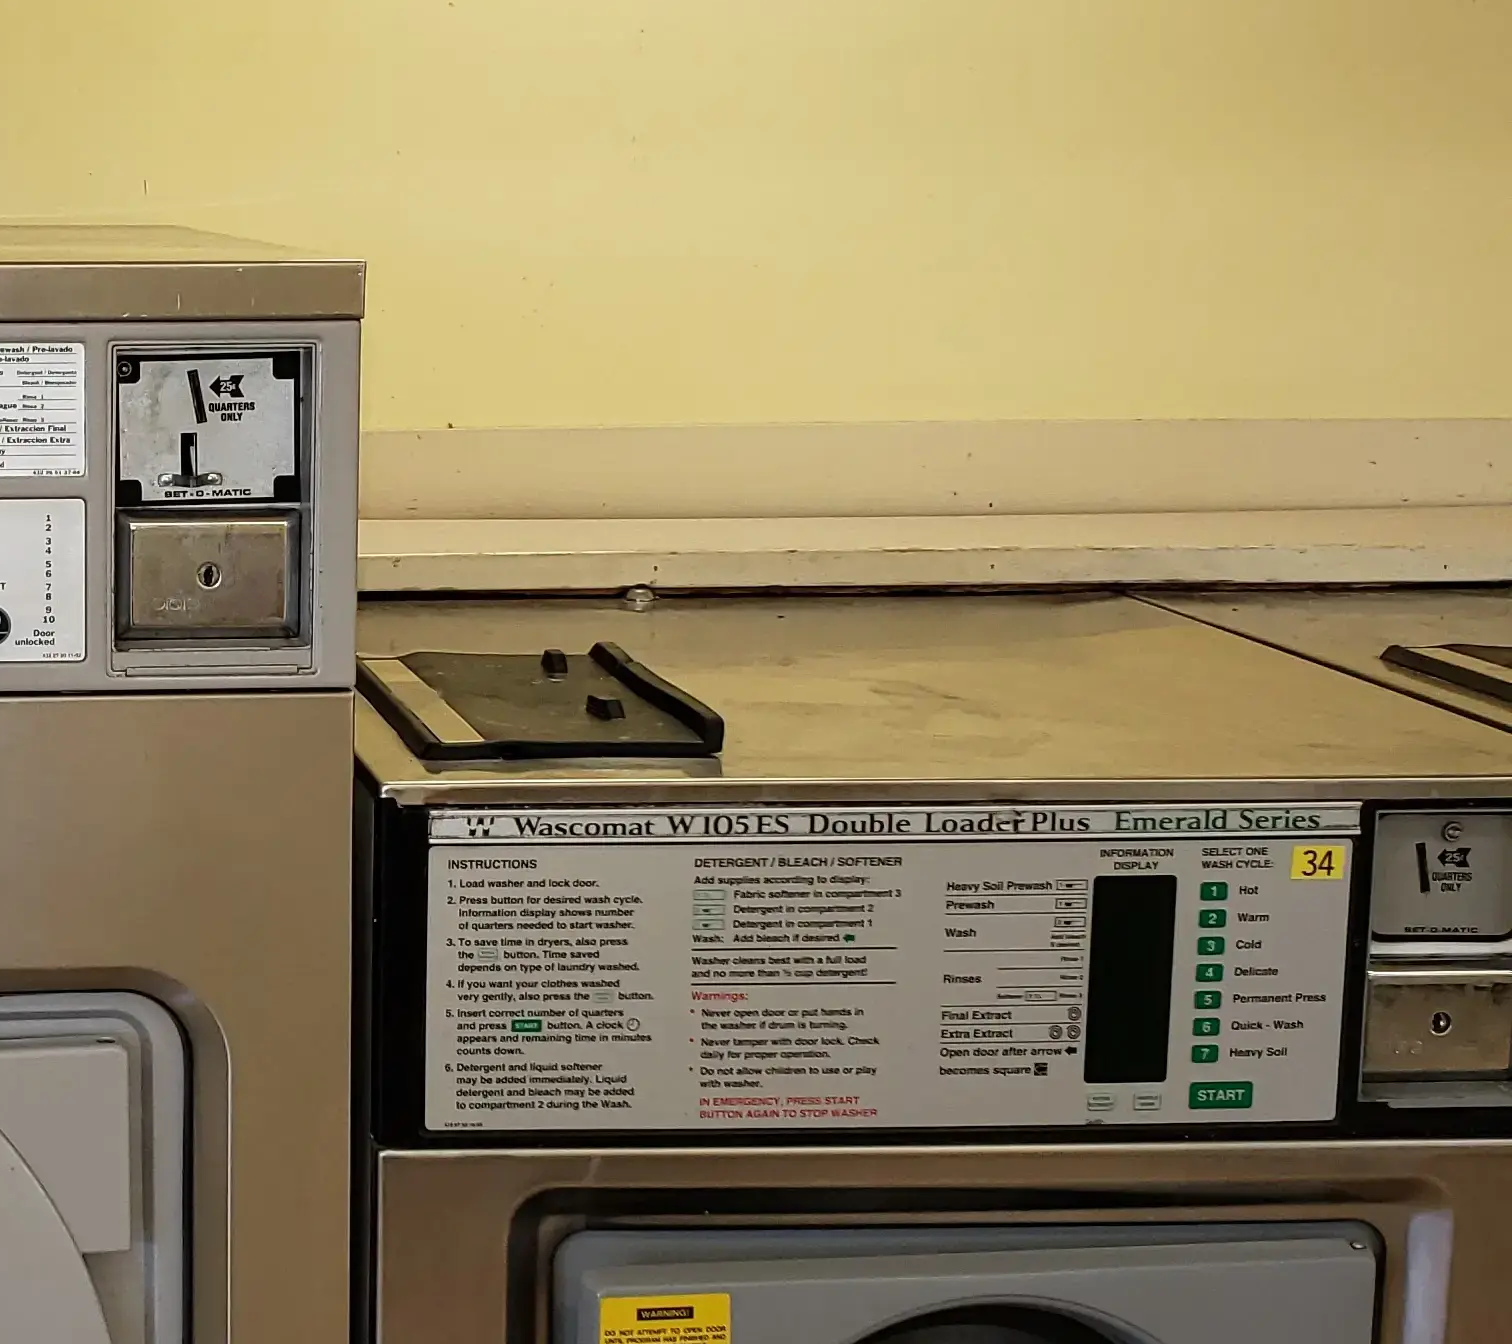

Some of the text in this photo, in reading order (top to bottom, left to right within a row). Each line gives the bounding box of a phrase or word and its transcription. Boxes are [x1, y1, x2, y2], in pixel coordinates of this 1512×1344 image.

[208, 401, 256, 413] QUARTERS
[220, 412, 243, 422] ONLY
[33, 629, 55, 638] Door
[514, 816, 655, 837] Wascomat
[808, 813, 912, 834] Double
[925, 813, 1028, 834] Loader
[1032, 813, 1091, 832] Plus
[1114, 810, 1228, 831] Emerald
[1239, 809, 1321, 830] Series
[1100, 848, 1174, 857] INFORMATION
[1201, 847, 1268, 856] SELECT ONE
[448, 859, 537, 869] INSTRUCTIONS
[1113, 861, 1158, 870] DISPLAY
[1201, 859, 1273, 868] WASH CYCLE:
[1301, 849, 1334, 876] 34
[1432, 871, 1472, 882] QUARTERS
[448, 878, 599, 888] 1. Load washer and lock door.
[946, 880, 1052, 893] Heavy Soil Prewash
[1440, 882, 1461, 892] ONLY
[1210, 885, 1216, 896] 1
[1239, 886, 1258, 894] Hot
[447, 895, 643, 905] 2. Press button for desired wash cycle.
[946, 900, 994, 909] Prewash
[1208, 913, 1217, 924] 2
[1237, 913, 1269, 921] Warm
[944, 928, 976, 937] Wash
[1207, 940, 1215, 951] 3
[1235, 939, 1261, 949] Cold
[1205, 967, 1213, 977] 4
[1234, 966, 1278, 976] Delicate
[943, 974, 982, 983] Rinses
[691, 990, 749, 1003] Warnings:
[1204, 994, 1212, 1005] 5
[1232, 992, 1326, 1003] Permanent Press
[941, 1010, 1012, 1020] Final Extract
[1202, 1021, 1211, 1032] 6
[1231, 1020, 1262, 1030] Quick
[1273, 1020, 1303, 1029] Wash
[940, 1028, 1012, 1038] Extra Extract
[940, 1047, 969, 1058] Open
[972, 1047, 999, 1056] door
[1001, 1046, 1027, 1056] after
[1201, 1048, 1209, 1059] 7
[1229, 1047, 1287, 1059] Heavy Soil
[939, 1065, 1031, 1077] becomes square
[1197, 1089, 1245, 1101] START
